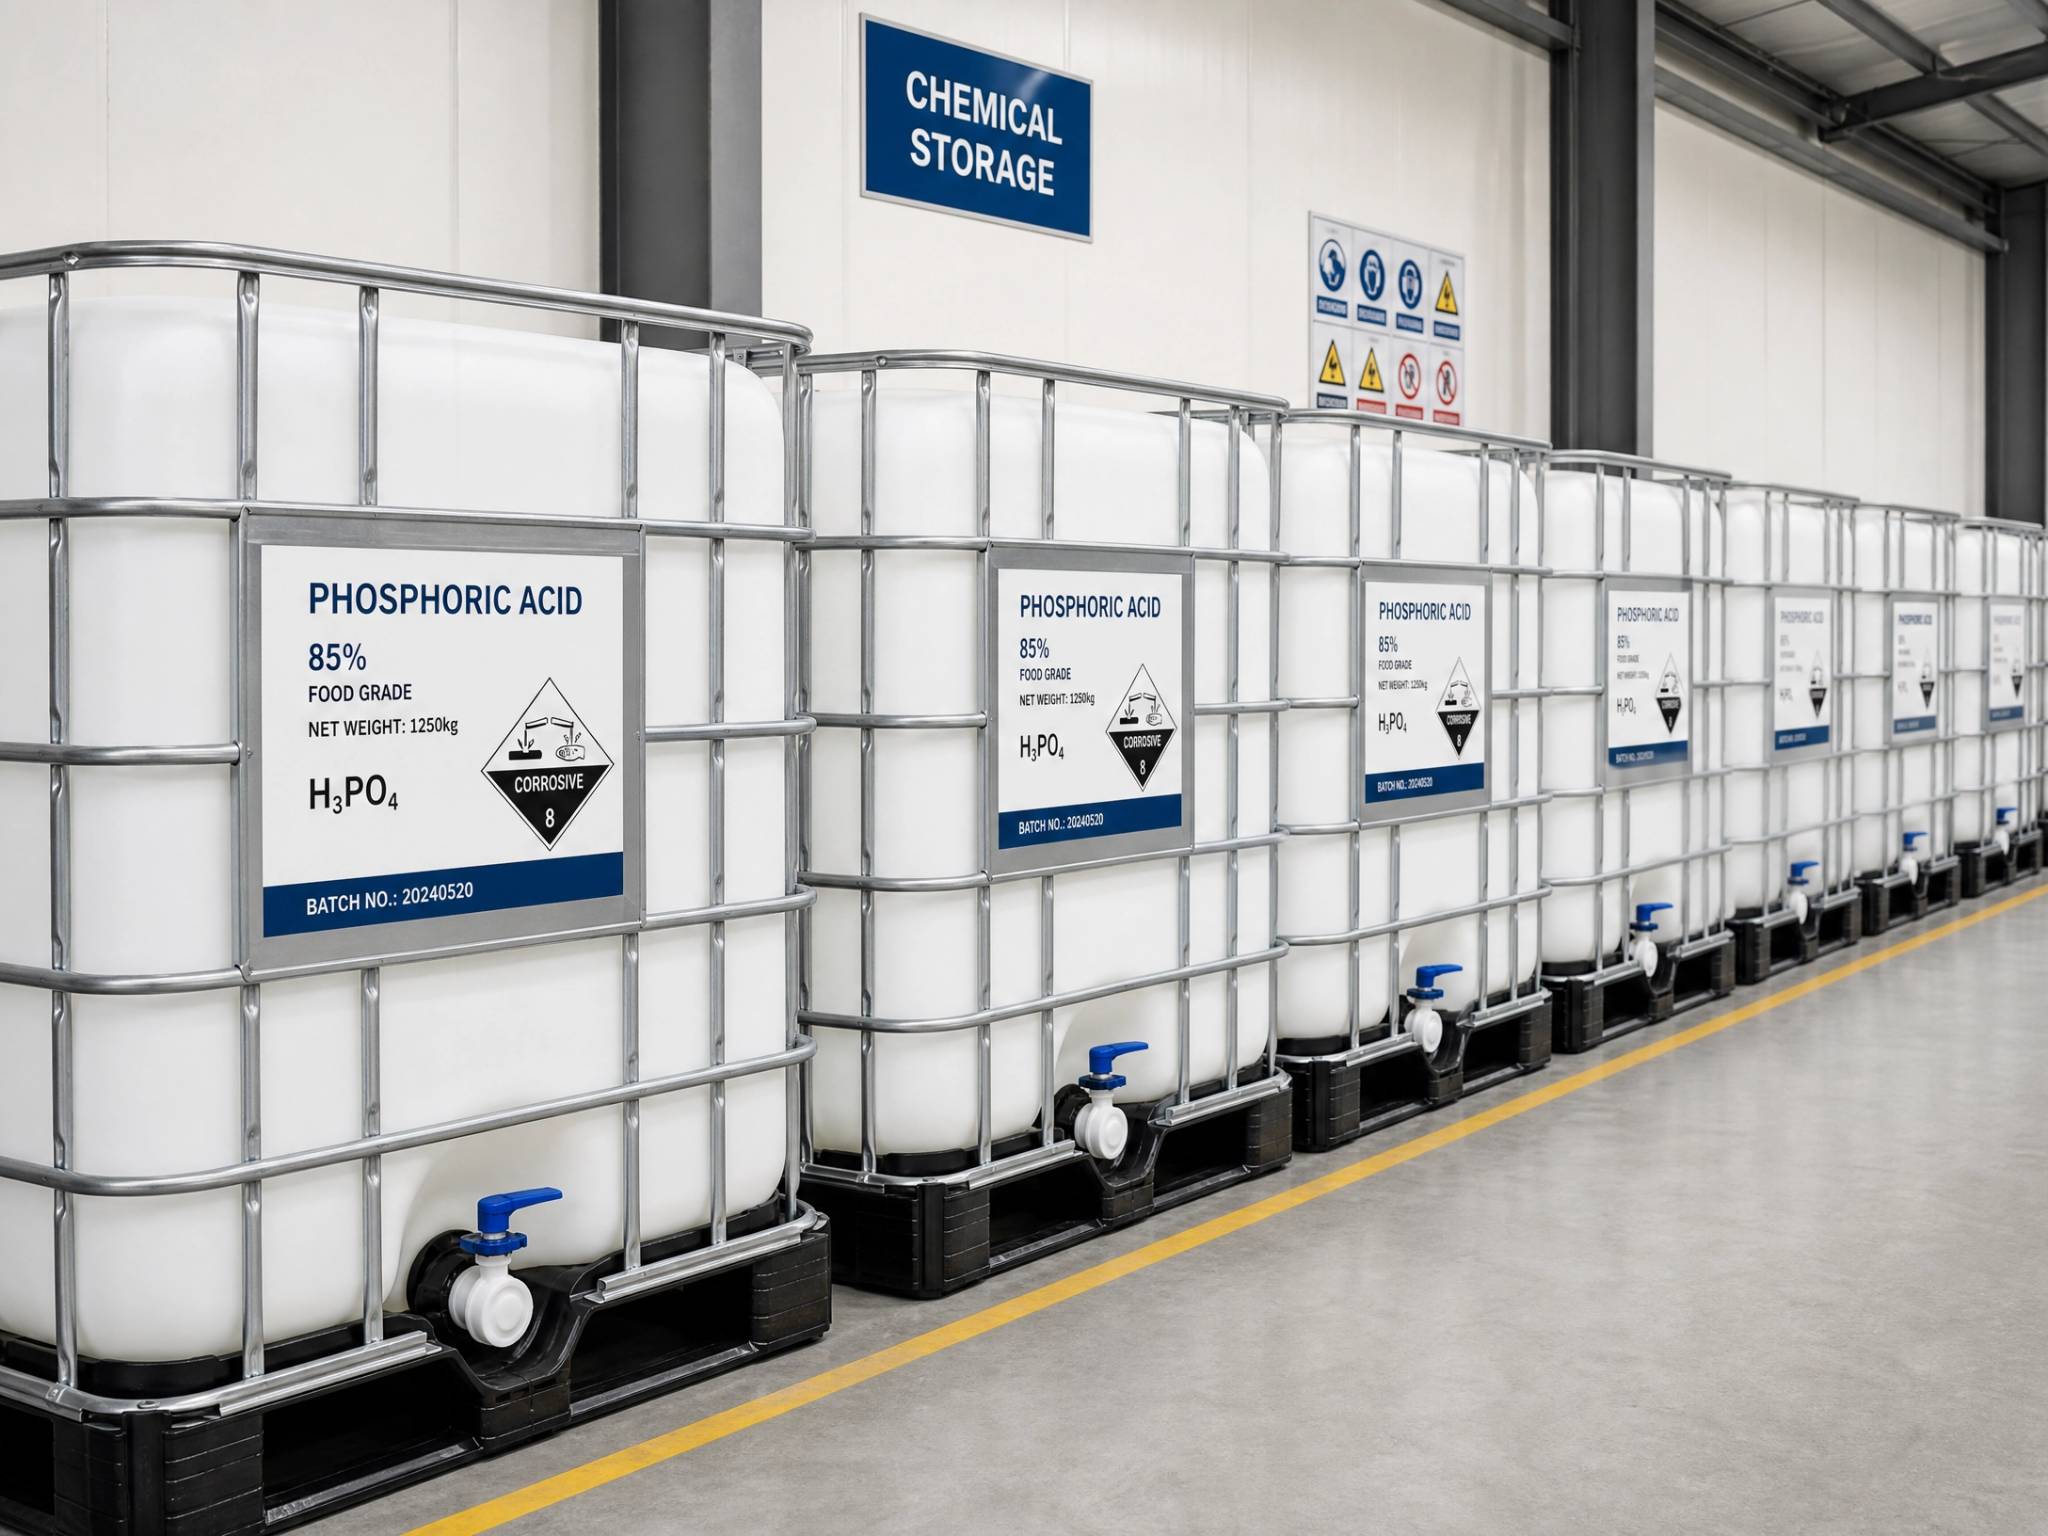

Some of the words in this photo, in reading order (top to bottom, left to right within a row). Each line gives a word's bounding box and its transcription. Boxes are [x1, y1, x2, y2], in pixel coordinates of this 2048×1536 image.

[907, 70, 1063, 145] CHEMICAL
[911, 128, 1054, 196] STORAGE
[310, 583, 511, 615] PHOSPHORIC
[519, 586, 582, 615] ACID
[1021, 595, 1123, 617] PHOSPHORIC
[1128, 596, 1160, 618] ACID
[1380, 602, 1446, 620] PHOSPHORIC
[1449, 603, 1471, 620] ACID
[1020, 638, 1049, 658] 85%
[1379, 636, 1398, 652] 85%
[309, 643, 366, 671] 85%
[1394, 660, 1412, 670] GRADE
[1020, 668, 1042, 681] FOOD
[1045, 668, 1071, 680] GRADE
[309, 685, 354, 702] FOOD
[359, 684, 412, 701] GRADE
[1020, 694, 1035, 706] NET
[1036, 693, 1068, 705] WEIGHT:
[1070, 692, 1095, 706] 1250kg
[309, 721, 339, 737] NET
[344, 719, 405, 736] WEIGHT:
[411, 717, 458, 735] 1250kg
[1124, 735, 1161, 749] CORROSIVE
[1140, 760, 1146, 775] 8
[515, 773, 583, 793] CORROSIVE
[546, 808, 554, 828] 8
[1019, 820, 1046, 834] BATCH
[1048, 818, 1065, 830] NO.:
[1067, 813, 1103, 828] 20240520
[307, 894, 360, 915] BATCH
[365, 891, 397, 909] NO.:
[403, 882, 473, 905] 20240520
